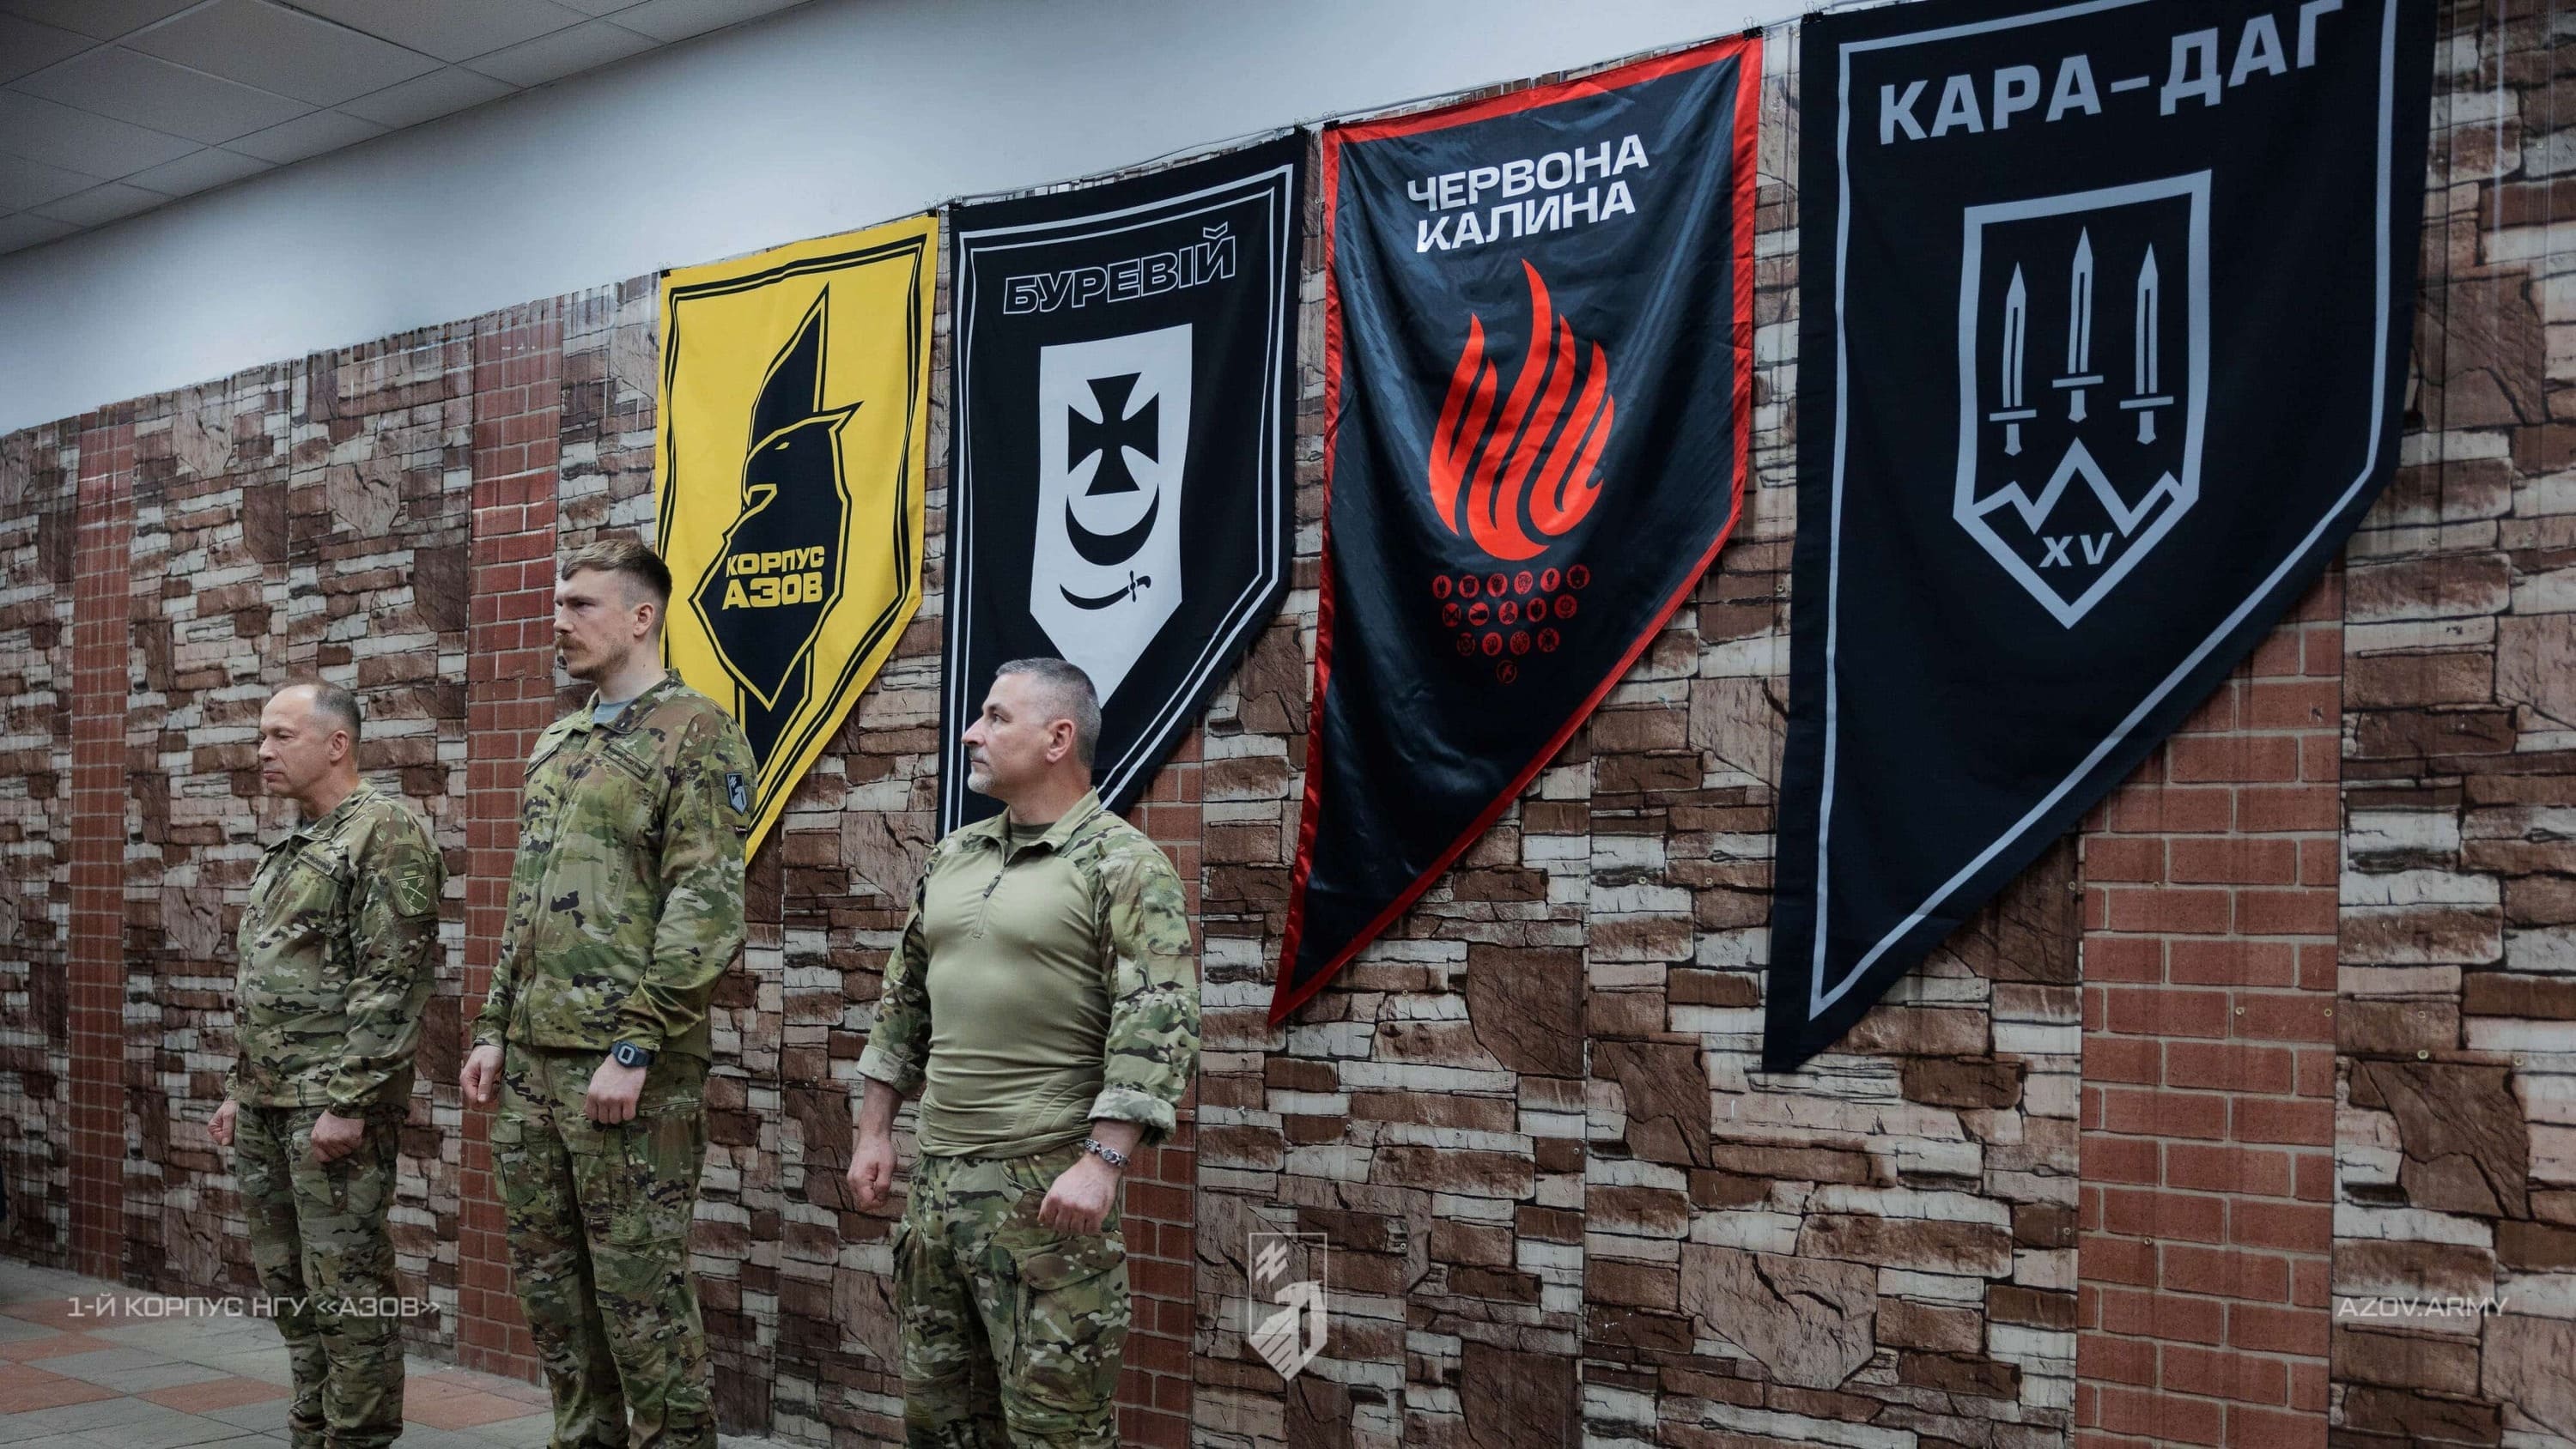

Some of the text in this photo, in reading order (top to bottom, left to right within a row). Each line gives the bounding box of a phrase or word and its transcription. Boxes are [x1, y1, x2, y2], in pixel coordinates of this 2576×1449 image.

[1407, 134, 1649, 212] ЧЕРВОНА
[1417, 179, 1636, 253] КАЛИНА
[1003, 221, 1236, 315] БУРЕВІЙ
[726, 545, 825, 578] КОРПУС
[2038, 532, 2113, 567] XV
[721, 571, 823, 610] АЗОВ
